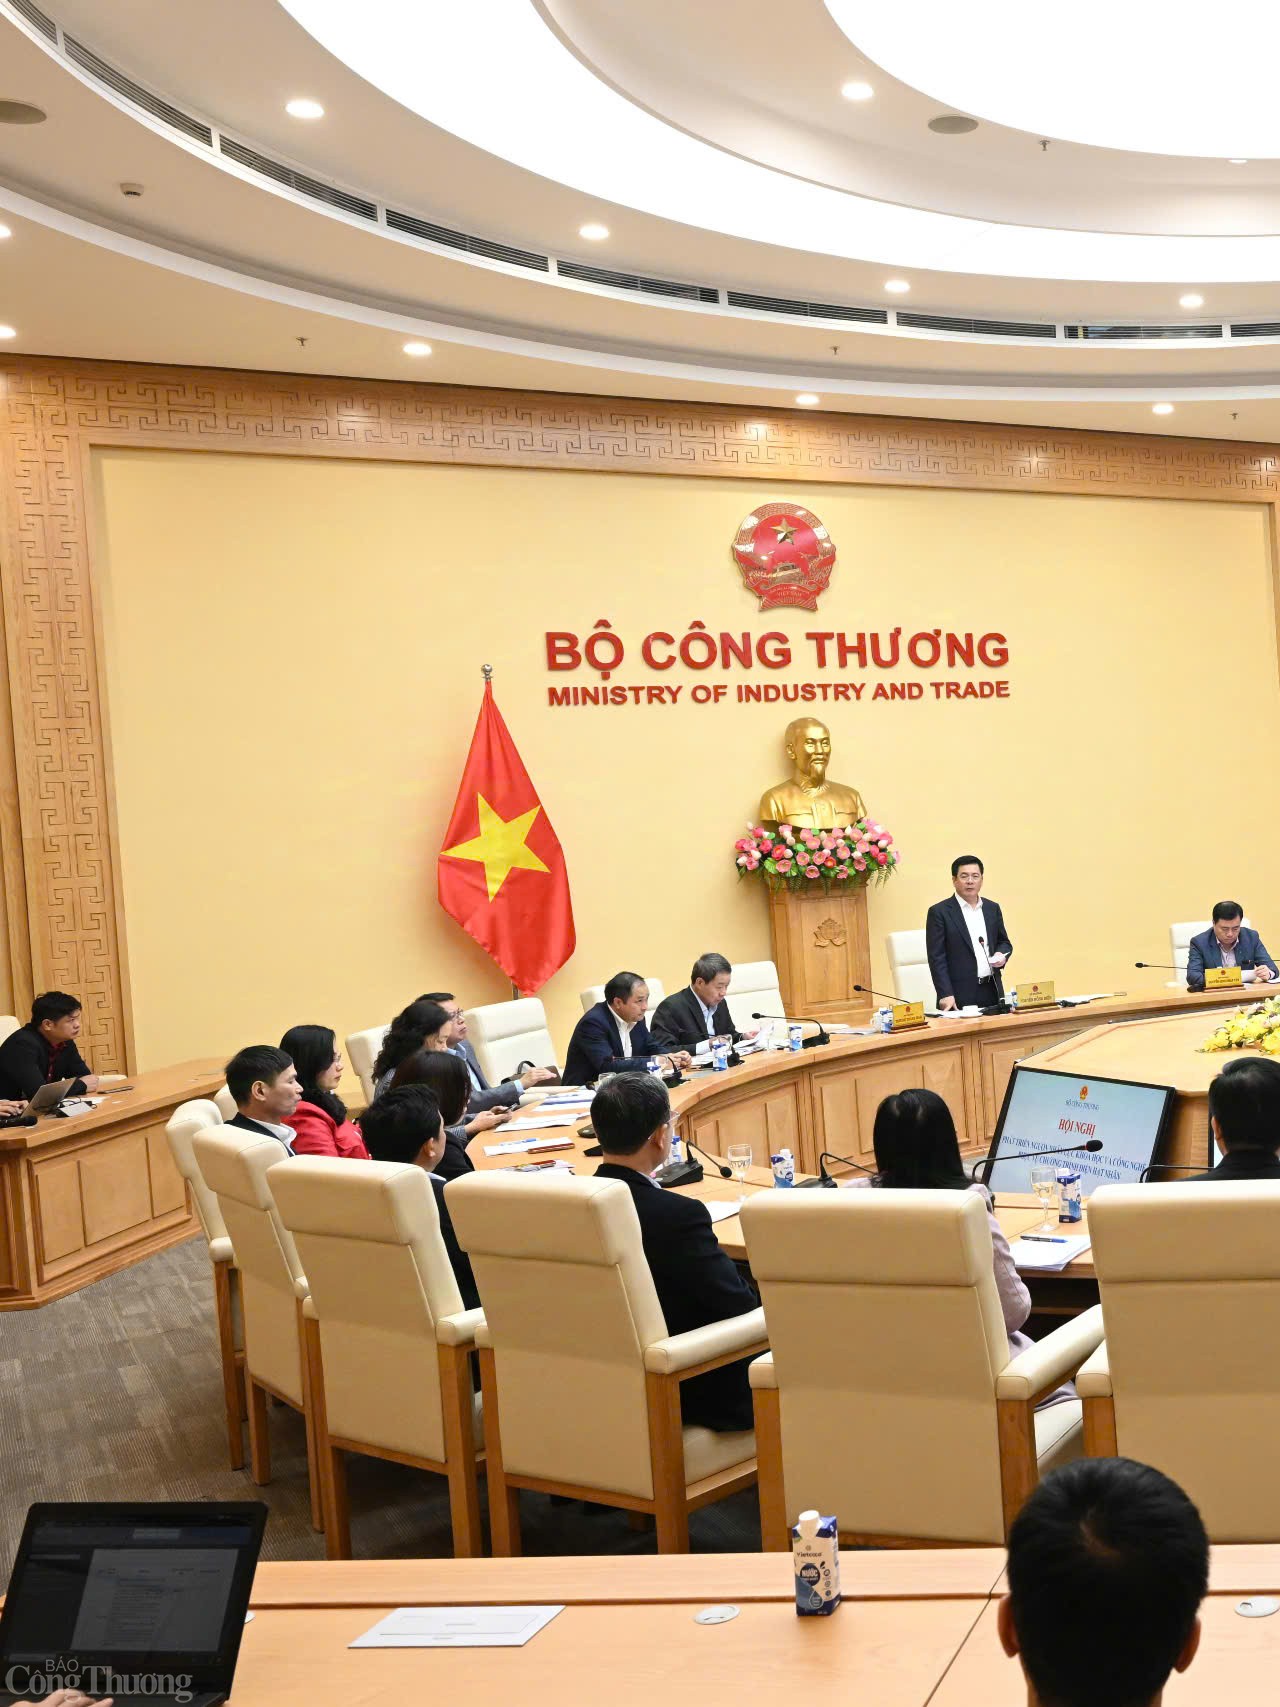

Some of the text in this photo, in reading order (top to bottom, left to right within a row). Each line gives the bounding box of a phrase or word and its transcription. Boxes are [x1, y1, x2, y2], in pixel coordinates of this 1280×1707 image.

[546, 619, 1010, 680] BỘ CÔNG THƯƠNG
[548, 680, 1011, 706] MINISTRY OF INDUSTRY AND TRADE
[1058, 1118, 1097, 1139] HỘI NGHỊ
